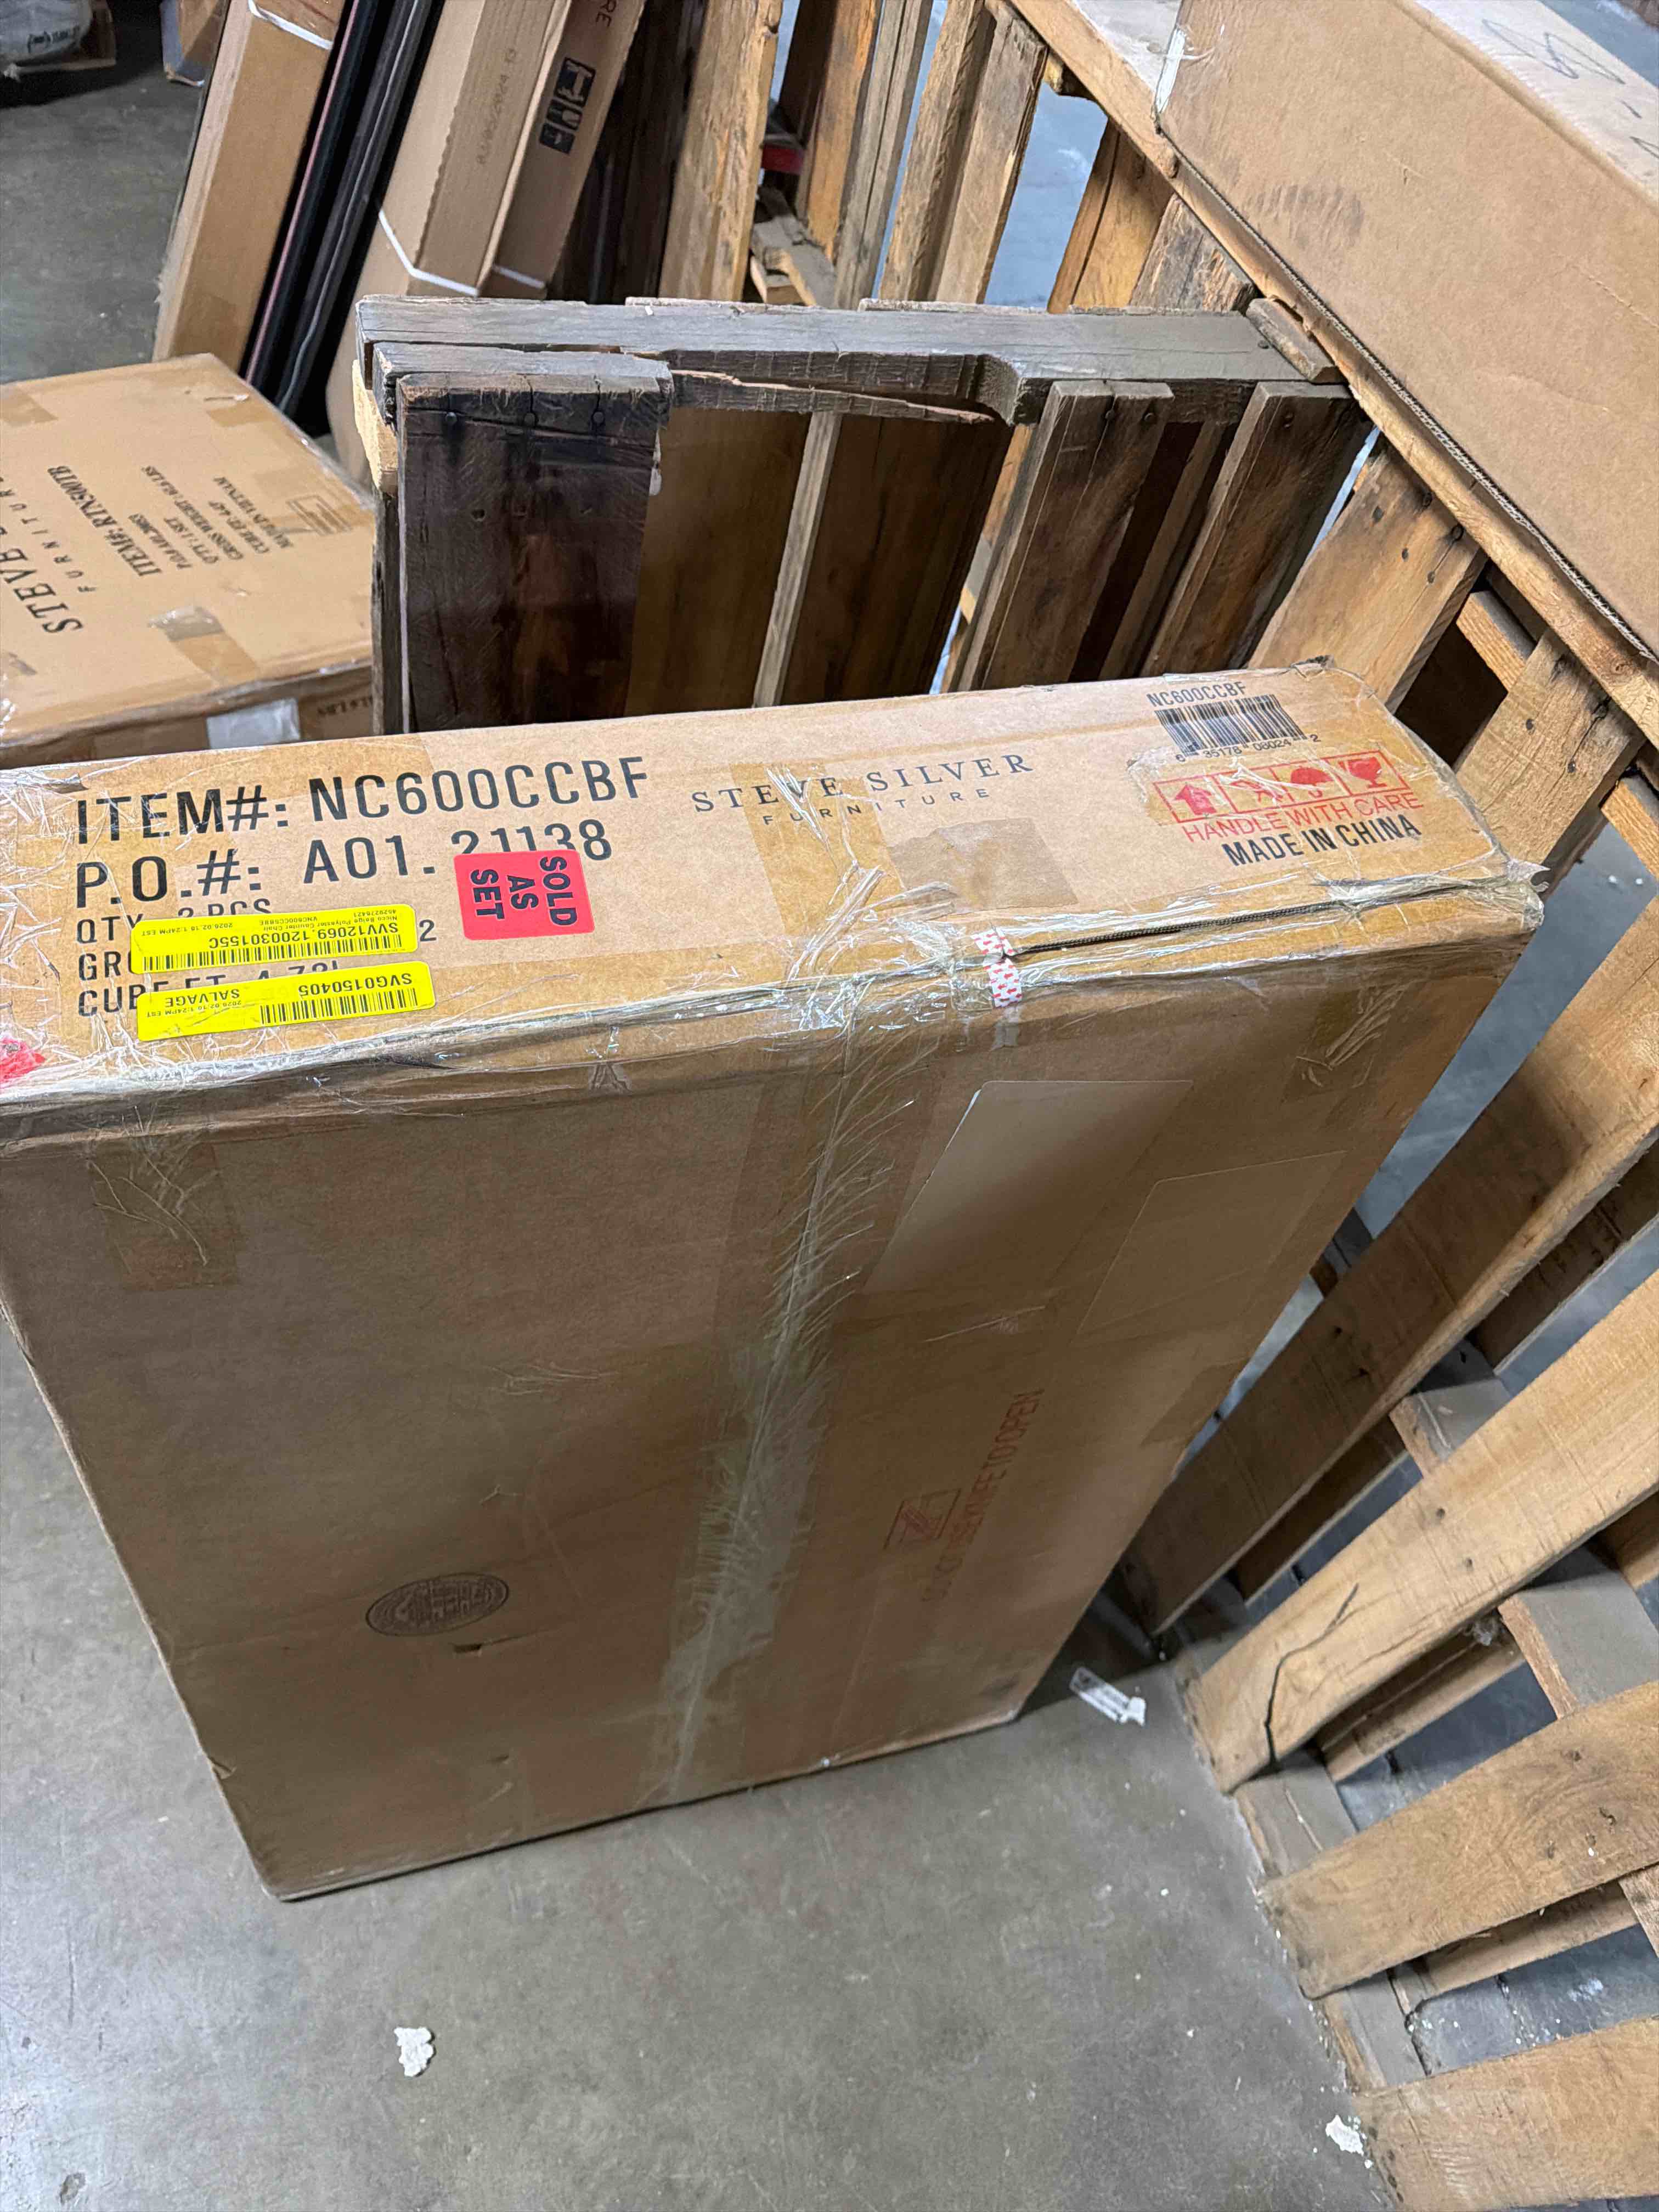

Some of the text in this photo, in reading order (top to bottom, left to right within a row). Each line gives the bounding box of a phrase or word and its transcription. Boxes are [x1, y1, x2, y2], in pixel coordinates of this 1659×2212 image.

[0, 476, 97, 592] FURNITUR
[1146, 681, 1246, 707] NC600CCBF
[1203, 746, 1243, 759] 35178
[1309, 734, 1322, 742] 2
[77, 756, 648, 844] ITEM#: NC600CCBF
[692, 754, 1034, 813] STEVE SILVER
[763, 788, 990, 826] FURNITURE
[1181, 792, 1424, 843] HANDLE WITH CARE
[1222, 814, 1422, 866] MADE IN CHINA
[470, 869, 505, 920] SET
[507, 875, 539, 910] AS
[539, 856, 578, 926] SOLD
[165, 988, 240, 1008] SALVAGE
[298, 973, 413, 997] SVG0150405
[146, 1011, 162, 1019] EST
